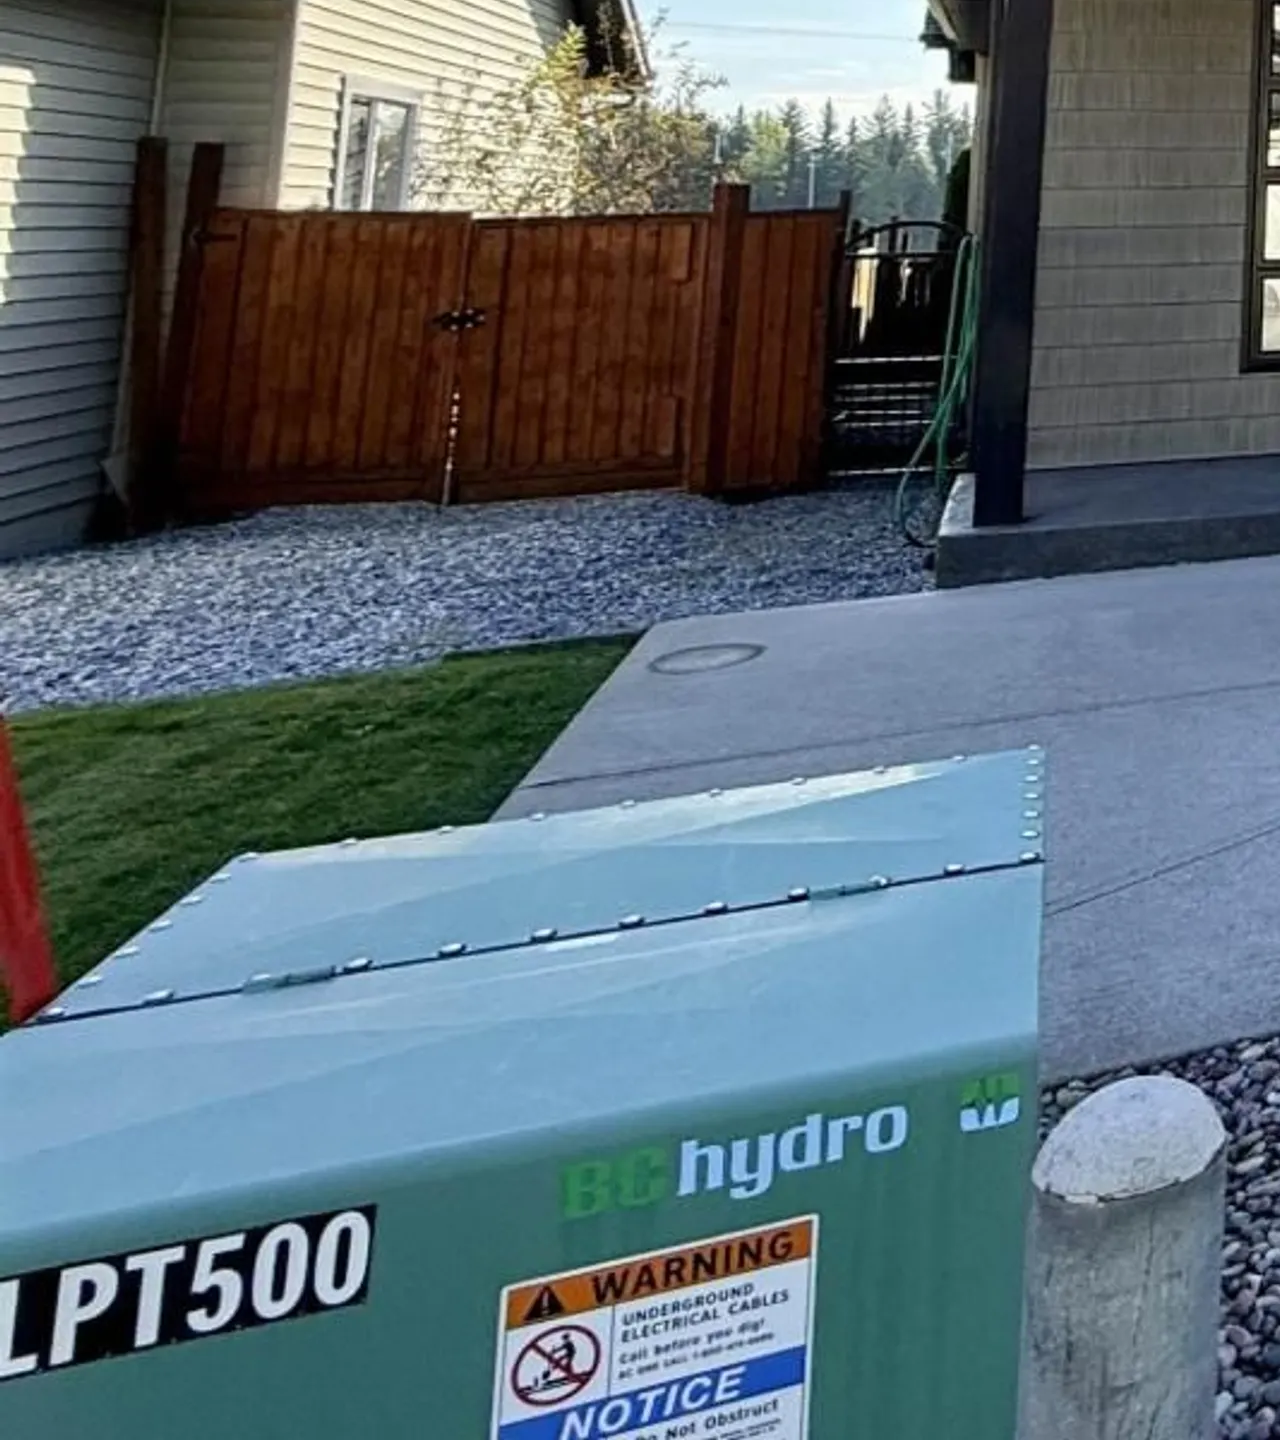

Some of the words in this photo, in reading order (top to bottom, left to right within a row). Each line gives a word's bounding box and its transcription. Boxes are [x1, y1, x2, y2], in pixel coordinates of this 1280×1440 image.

[0, 1210, 371, 1377] LPT500
[592, 1231, 794, 1304] WARNING
[621, 1309, 721, 1343] ELECTRICAL
[728, 1288, 790, 1315] CABLES
[622, 1282, 755, 1326] UNDERGROUND
[619, 1346, 648, 1365] Call
[653, 1335, 701, 1356] before
[559, 1365, 748, 1440] NOTICE
[666, 1422, 697, 1440] Not
[704, 1398, 779, 1430] Obstruct
